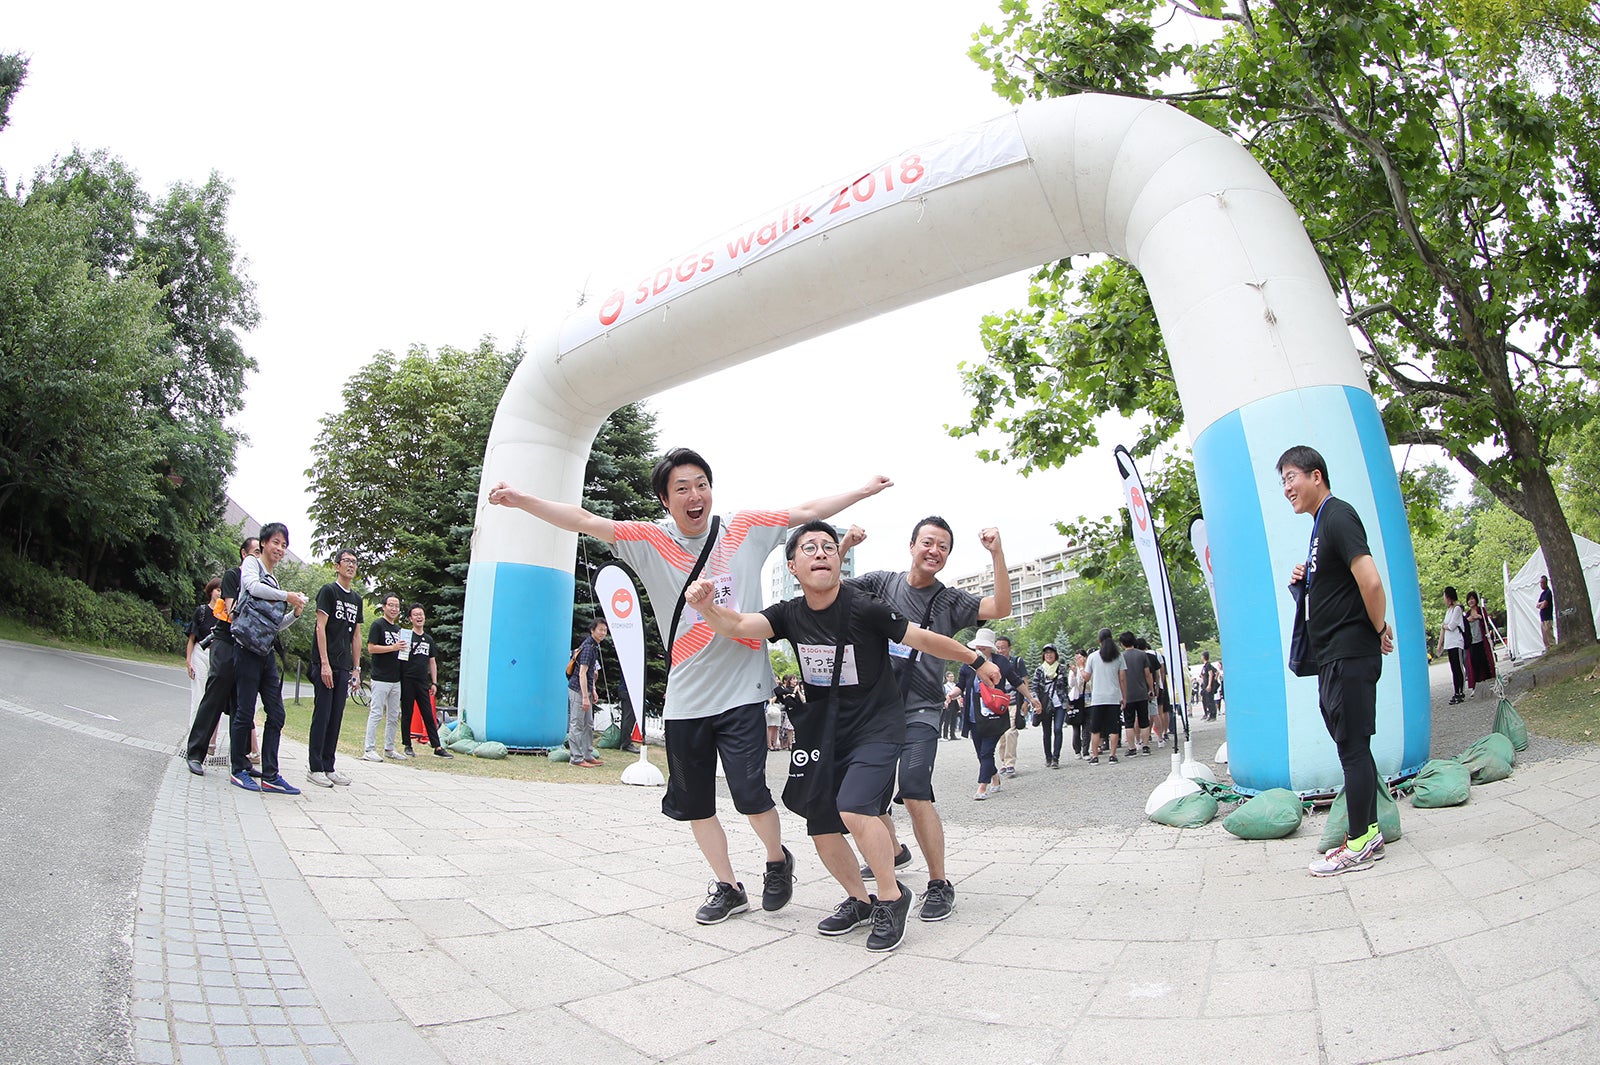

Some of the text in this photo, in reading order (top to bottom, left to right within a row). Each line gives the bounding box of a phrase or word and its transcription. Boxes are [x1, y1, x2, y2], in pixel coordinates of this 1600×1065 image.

[635, 154, 924, 304] SDGs walk 2018
